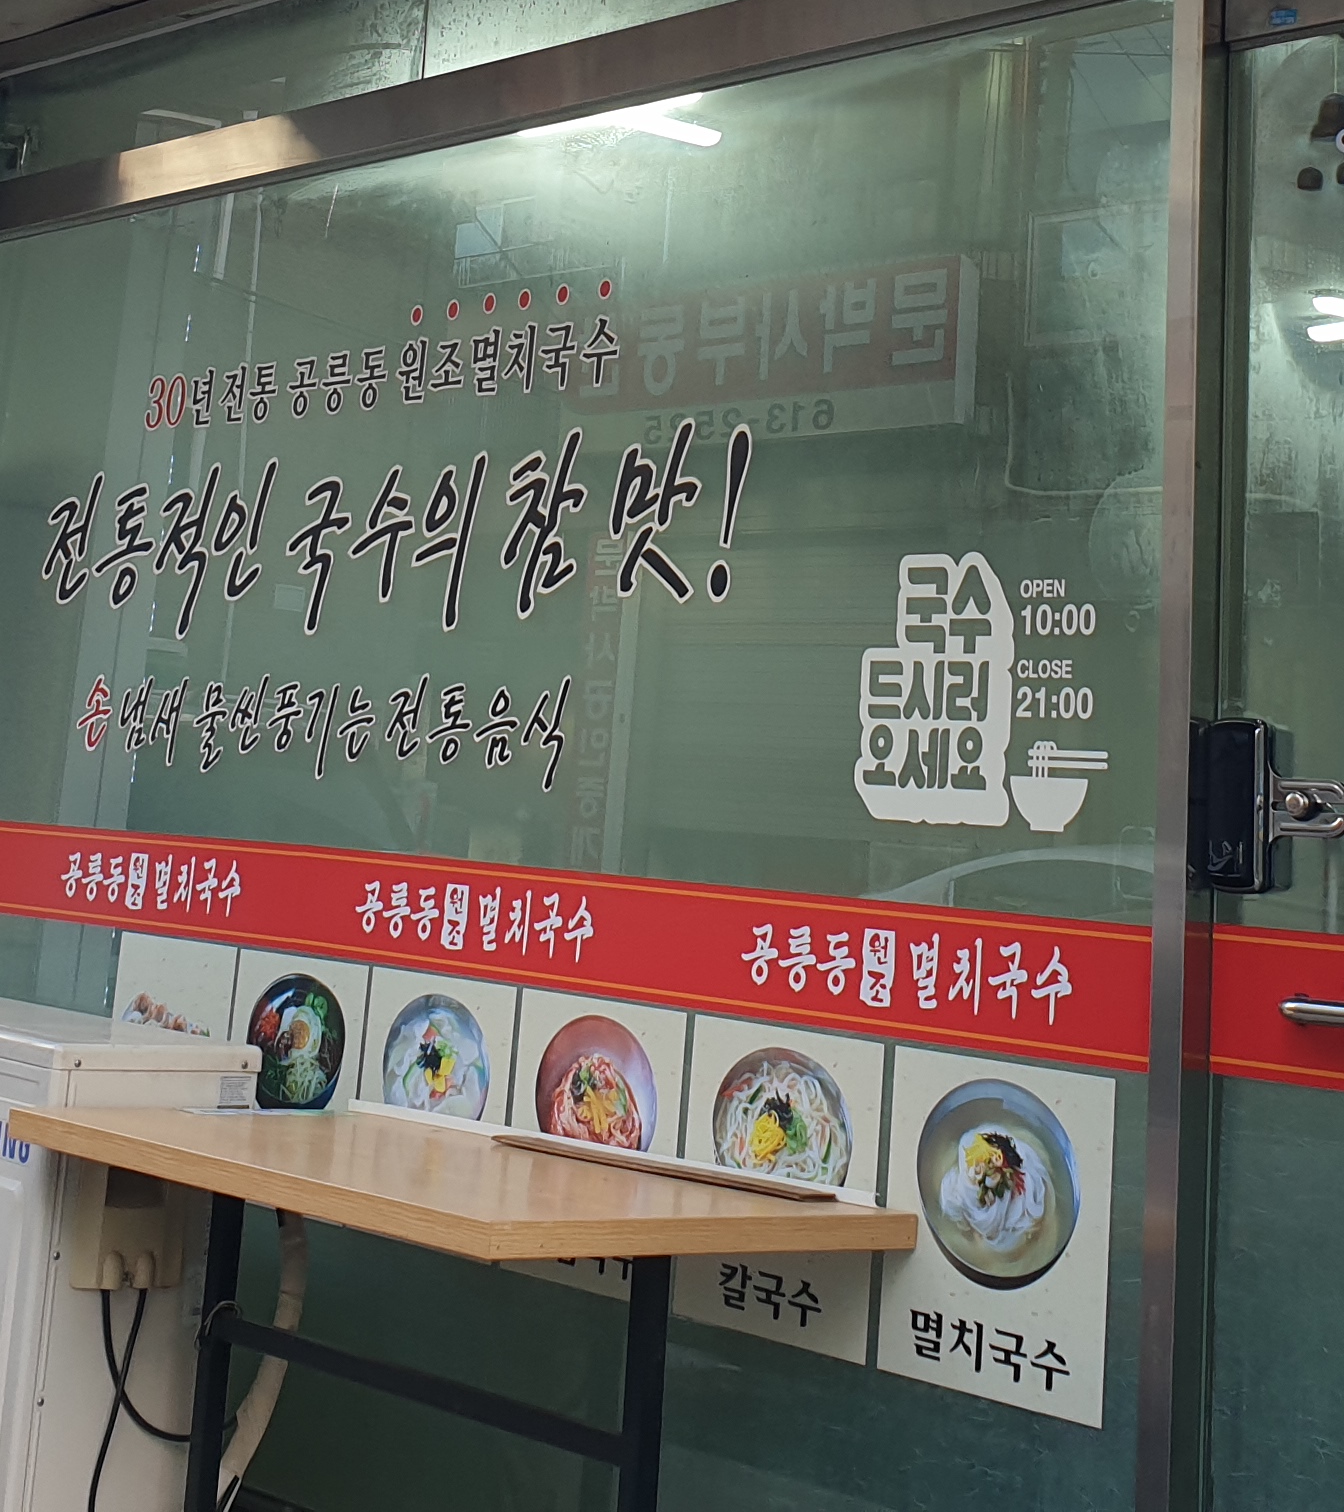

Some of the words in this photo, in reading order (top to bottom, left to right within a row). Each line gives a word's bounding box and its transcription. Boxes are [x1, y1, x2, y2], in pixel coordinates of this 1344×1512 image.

[144, 355, 280, 431] 30년전통
[287, 348, 390, 422] 공릉동
[399, 316, 623, 409] 원조멸치국수
[40, 456, 280, 639] 전통적인
[285, 450, 490, 636] 국수의
[904, 563, 994, 655] 국수
[1019, 578, 1066, 599] OPEN
[1020, 603, 1097, 637] 10:00
[867, 659, 989, 723] 드시러
[1015, 686, 1095, 720] 21:00
[1016, 659, 1073, 680] CLOSE
[862, 725, 988, 792] 오세요
[60, 850, 126, 904] 공릉동
[154, 853, 243, 918] 멸치국수
[355, 879, 440, 944] 공릉동
[477, 885, 596, 965] 멸치국수
[740, 920, 859, 999] 공릉동
[908, 928, 1075, 1028] 멸치국수
[717, 1262, 823, 1329] 칼국수
[908, 1309, 1073, 1394] 멸치국수
